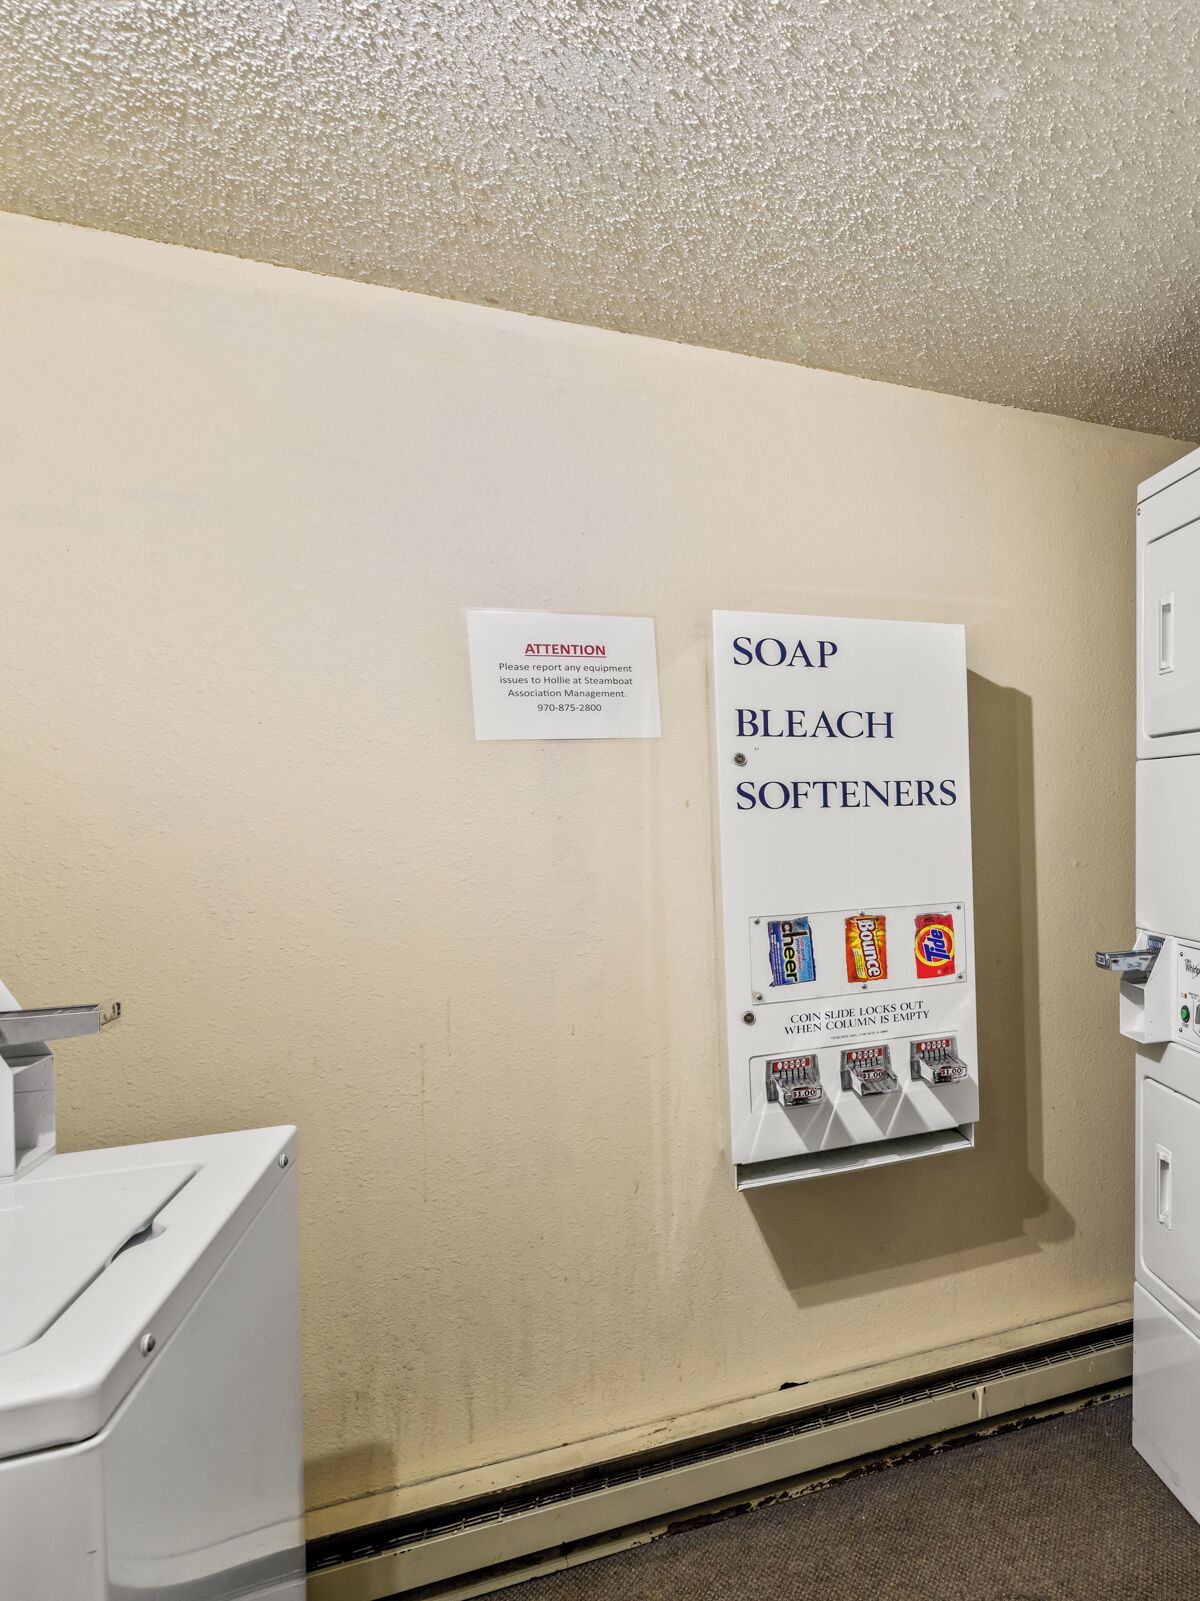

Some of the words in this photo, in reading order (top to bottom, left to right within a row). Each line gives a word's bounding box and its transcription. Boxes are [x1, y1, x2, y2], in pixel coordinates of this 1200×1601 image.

[525, 643, 606, 657] ATTENTION
[733, 636, 838, 668] SOAP
[499, 663, 530, 671] Please
[532, 663, 562, 672] report
[564, 664, 581, 672] any
[583, 664, 632, 673] equipment
[499, 675, 529, 684] issues
[531, 676, 541, 684] to
[543, 675, 571, 684] Hollie
[573, 677, 582, 685] at
[584, 676, 633, 685] Steamboat
[508, 689, 562, 697] Association
[564, 689, 628, 698] Management.
[537, 704, 602, 712] 970-875-2800
[734, 708, 895, 739] BLEACH
[736, 779, 957, 810] SOFTENERS
[781, 920, 808, 982] cheer
[856, 919, 881, 978] Bounce
[923, 928, 951, 962] Tide
[790, 1011, 821, 1024] COIN
[824, 1008, 856, 1020] SLIDE
[859, 1003, 897, 1016] LOCKS
[900, 1000, 924, 1012] OUT
[784, 1022, 822, 1035] WHEN
[825, 1016, 876, 1031] COLUMN
[880, 1014, 890, 1024] IS
[893, 1010, 930, 1023] EMPTY
[862, 1071, 884, 1079] $1.00
[941, 1067, 962, 1076] $1.00
[792, 1088, 816, 1098] $1.00
